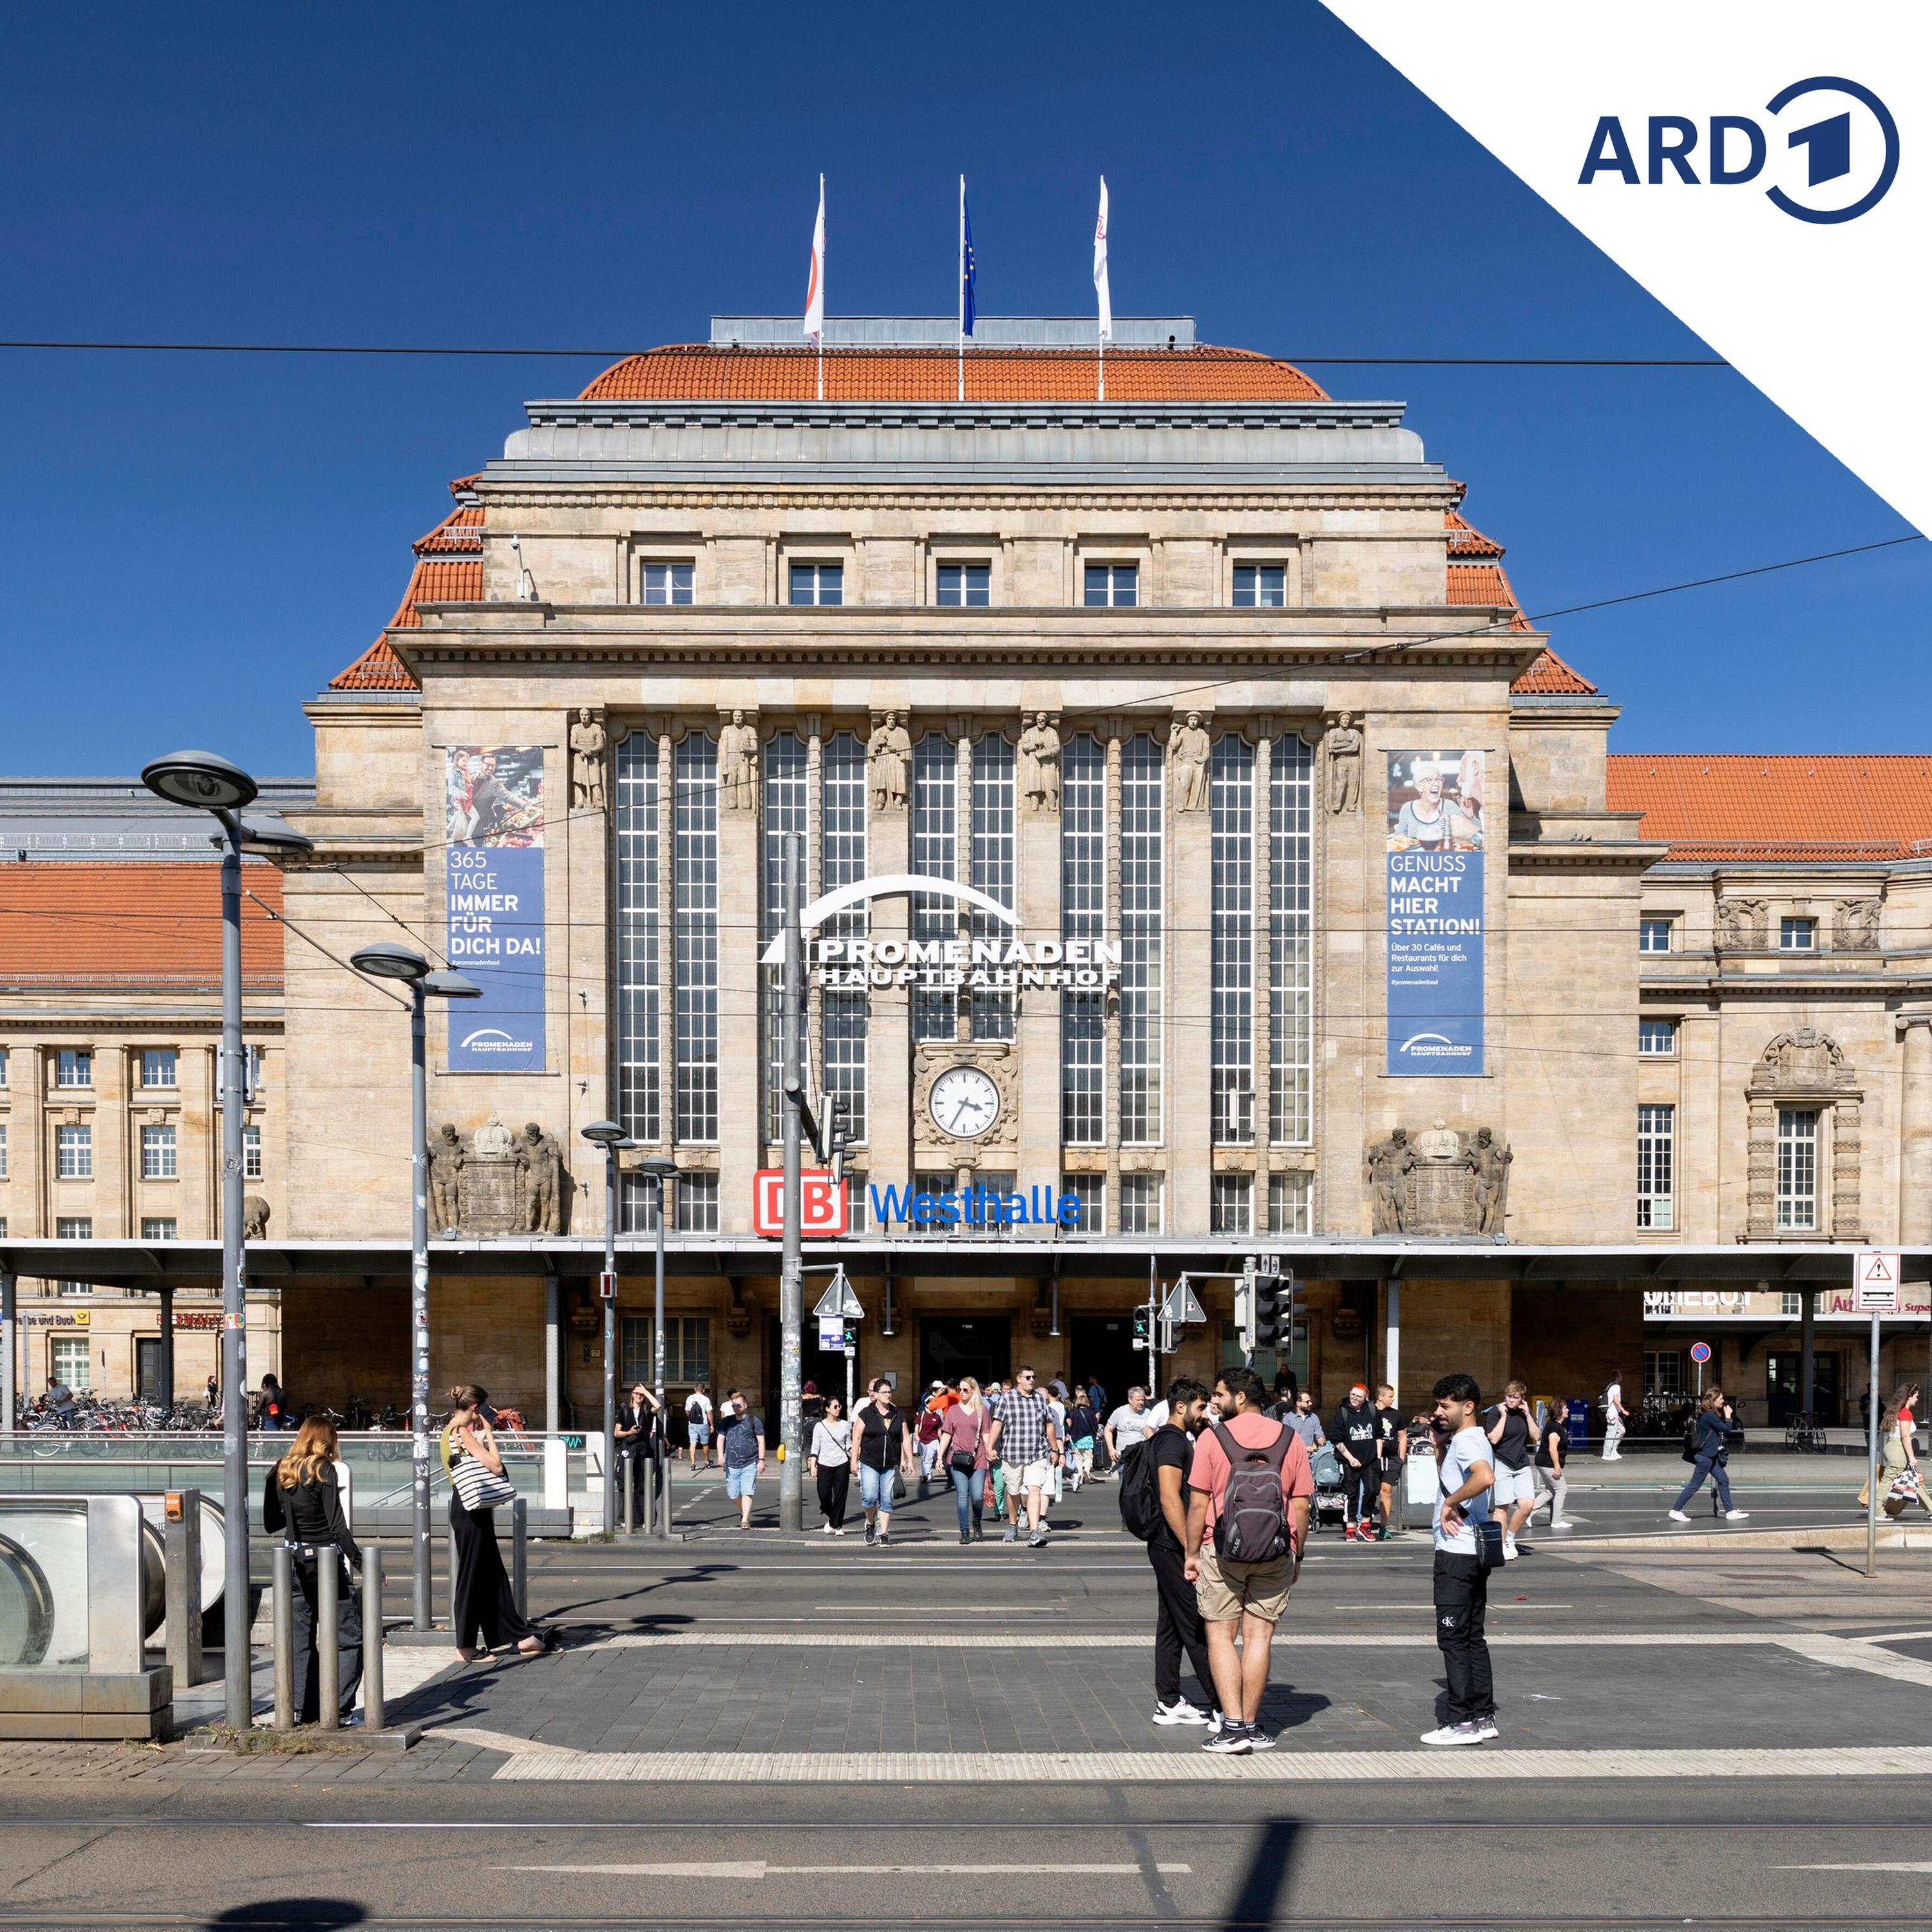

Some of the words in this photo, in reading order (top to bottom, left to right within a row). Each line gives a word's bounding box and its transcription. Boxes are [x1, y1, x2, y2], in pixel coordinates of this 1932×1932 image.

[451, 851, 487, 868] 365
[1391, 855, 1466, 872] GENUSS
[451, 873, 498, 889] TAGE
[1391, 876, 1462, 893] MACHT
[451, 895, 518, 911] IMMER
[1391, 898, 1438, 914] HIER
[451, 912, 493, 933] FÜR
[1390, 918, 1481, 935] STATION!
[451, 938, 500, 954] DICH
[506, 938, 541, 954] DA!
[819, 940, 1122, 965] PROMENADEN
[1391, 943, 1410, 951] Über
[819, 969, 1122, 985] HAUPTBAHNHOF
[768, 1182, 834, 1224] DB
[871, 1184, 1081, 1224] Westhalle
[55, 1315, 76, 1325] Buch
